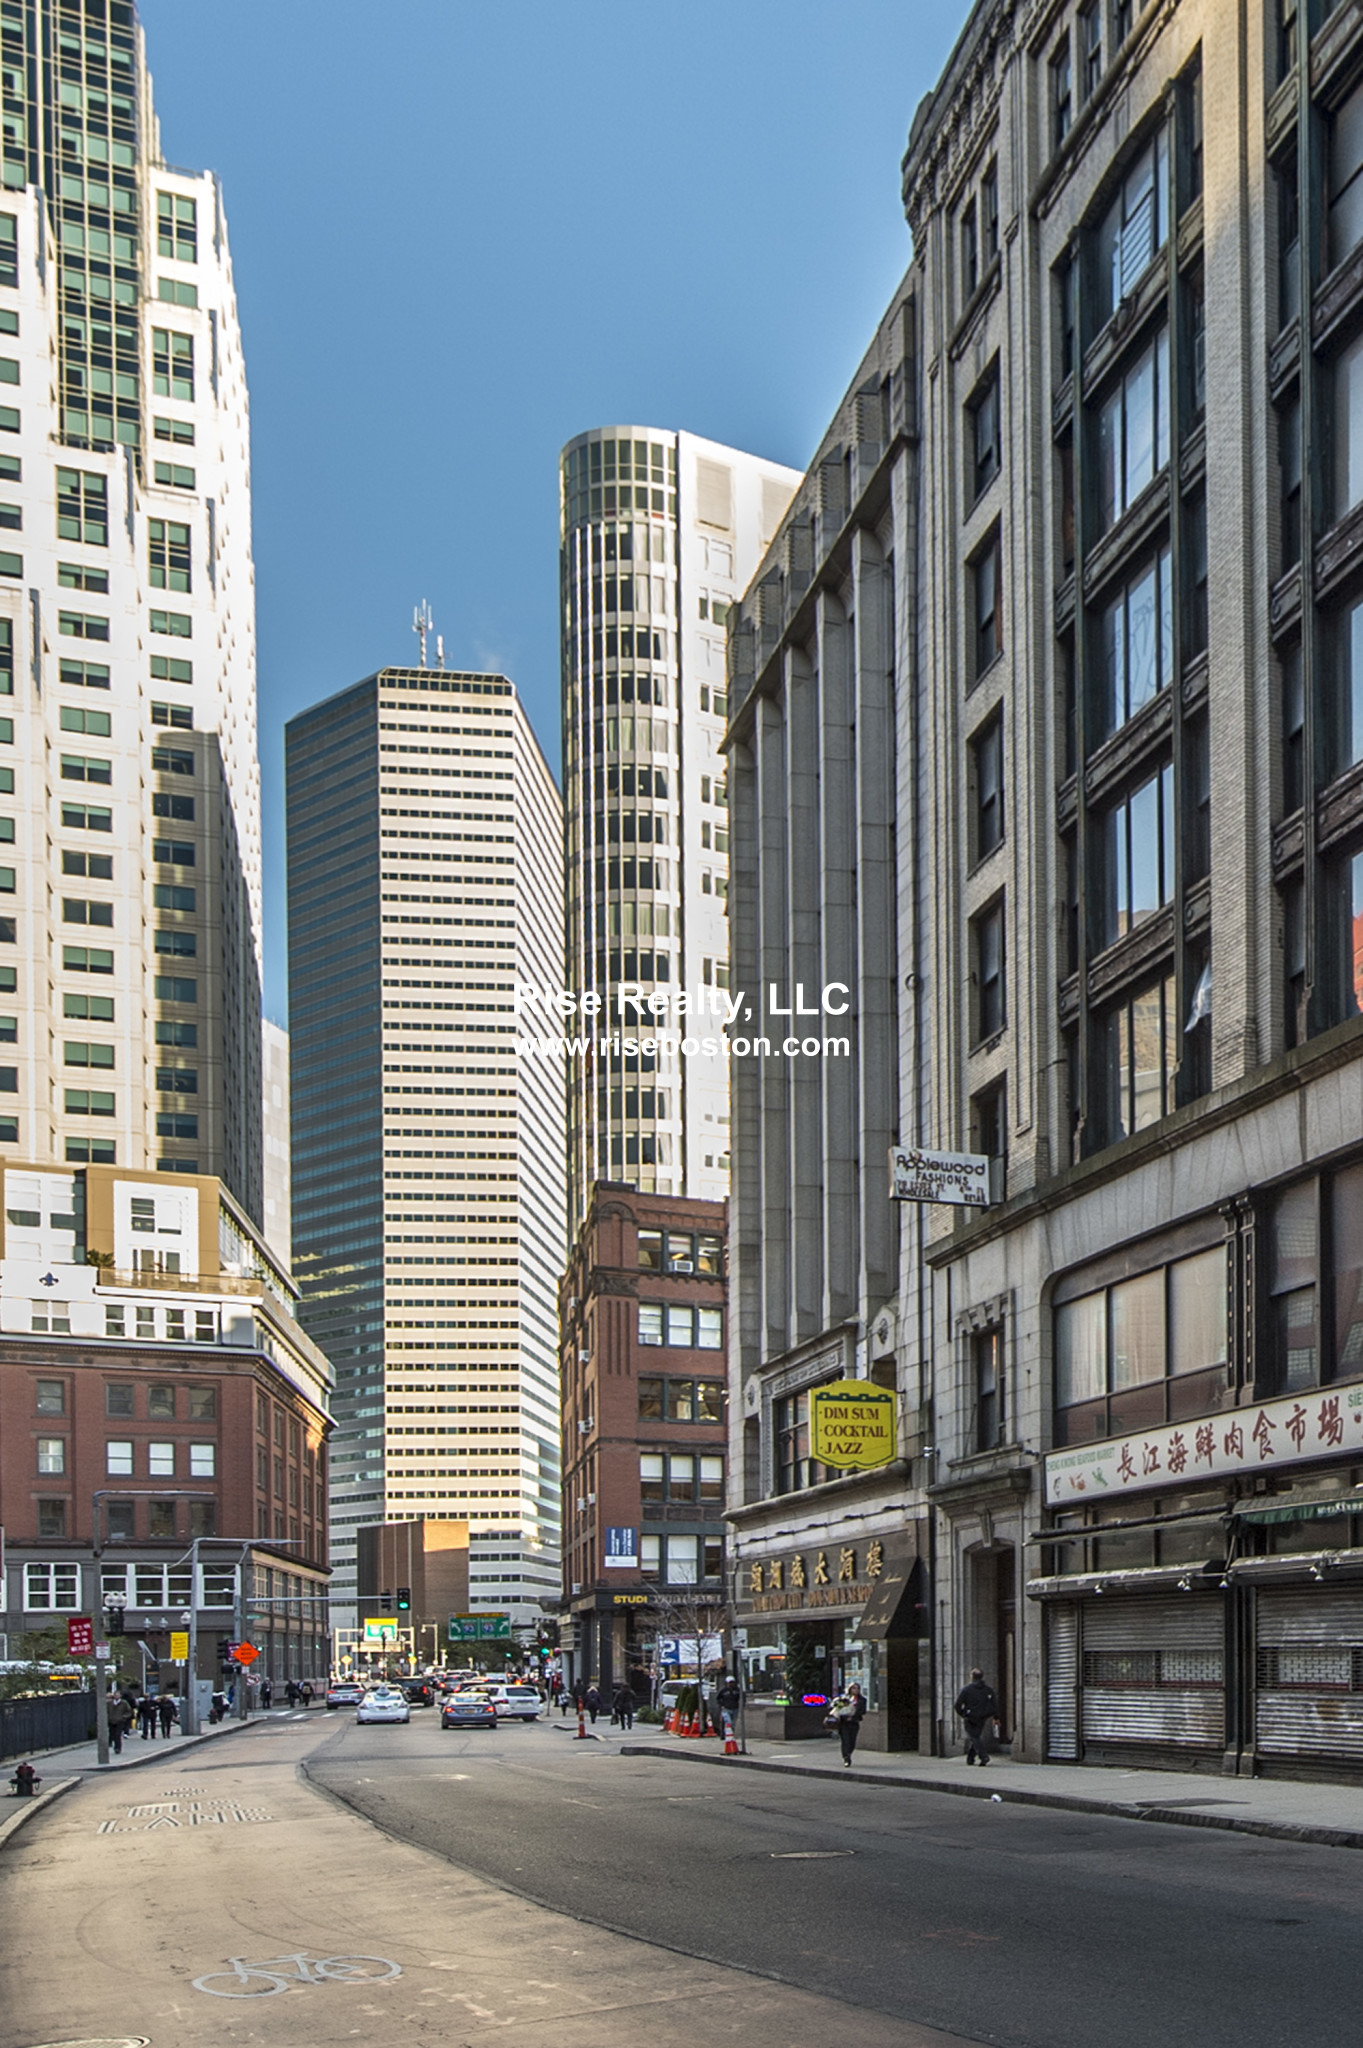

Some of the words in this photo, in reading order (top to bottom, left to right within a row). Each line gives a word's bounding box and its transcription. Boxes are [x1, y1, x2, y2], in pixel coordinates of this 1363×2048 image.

[896, 1154, 986, 1176] Applewood
[916, 1171, 969, 1186] FASHIONS
[824, 1406, 848, 1420] DIM
[851, 1407, 879, 1420] SUM
[824, 1424, 888, 1438] COCKTAIL
[1115, 1395, 1344, 1484] 長江海鮮肉食市場
[824, 1441, 863, 1455] JAZZ
[96, 1807, 274, 1834] LANE
